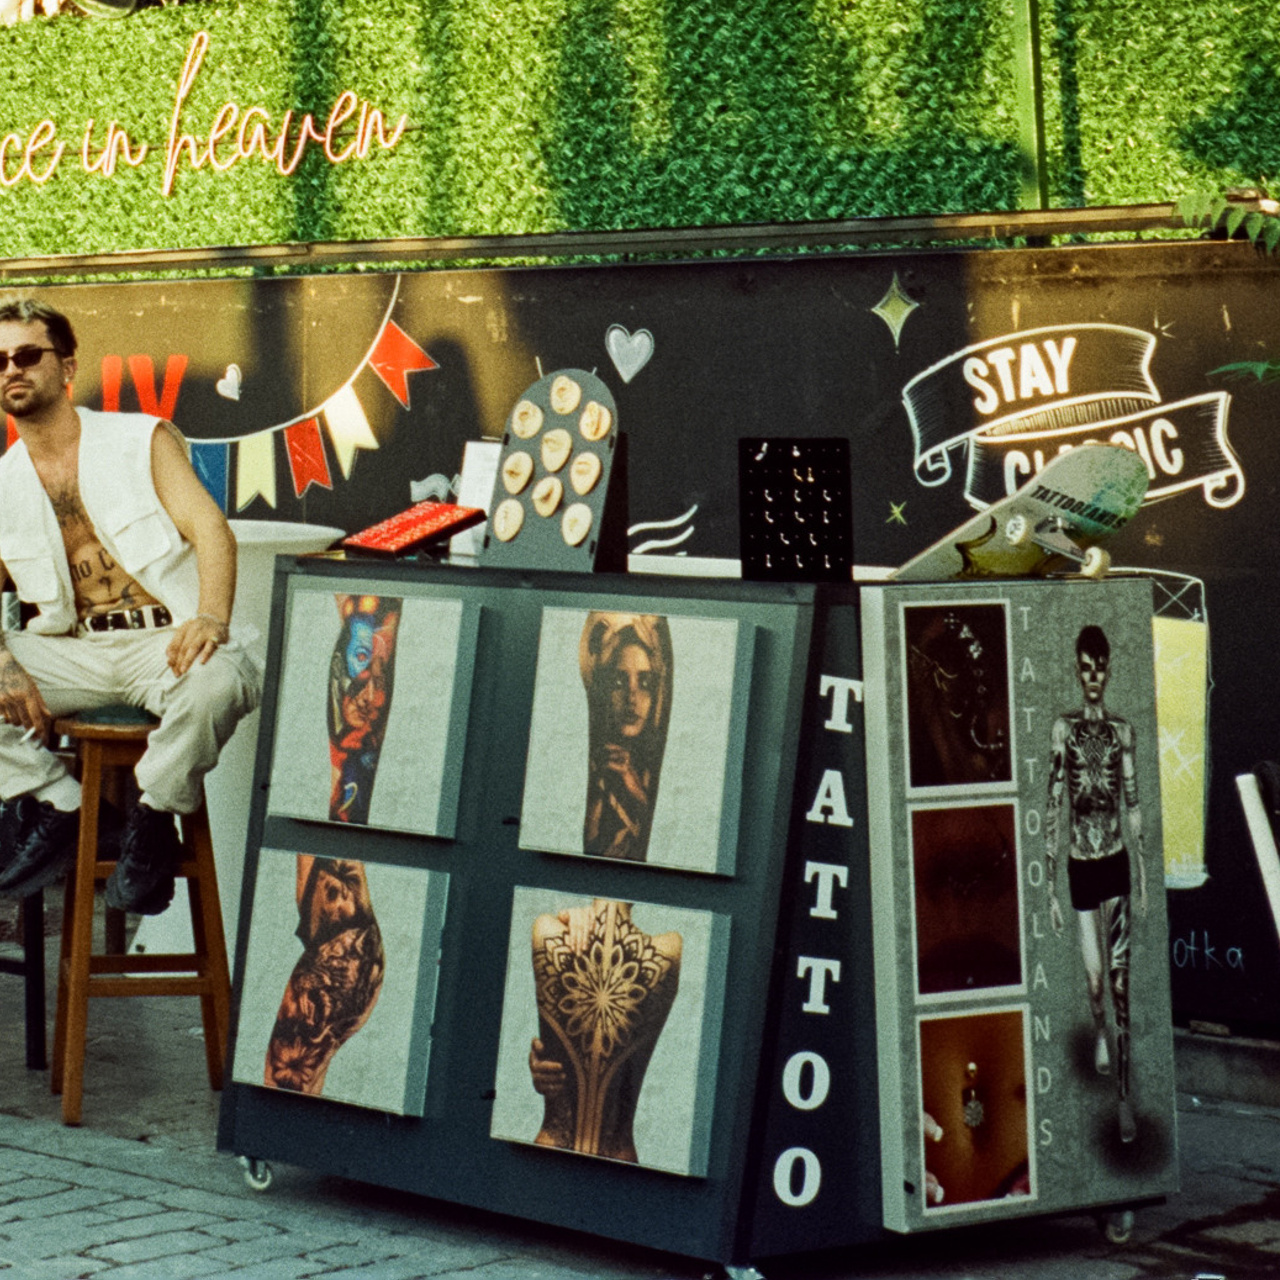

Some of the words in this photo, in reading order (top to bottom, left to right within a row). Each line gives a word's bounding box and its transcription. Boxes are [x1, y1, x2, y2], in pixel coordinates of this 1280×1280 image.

[81, 118, 148, 178] in
[160, 30, 408, 197] heaven
[962, 336, 1078, 416] STAY
[773, 674, 863, 1208] TATTOO
[1019, 605, 1054, 1148] TATTOOLANDS
